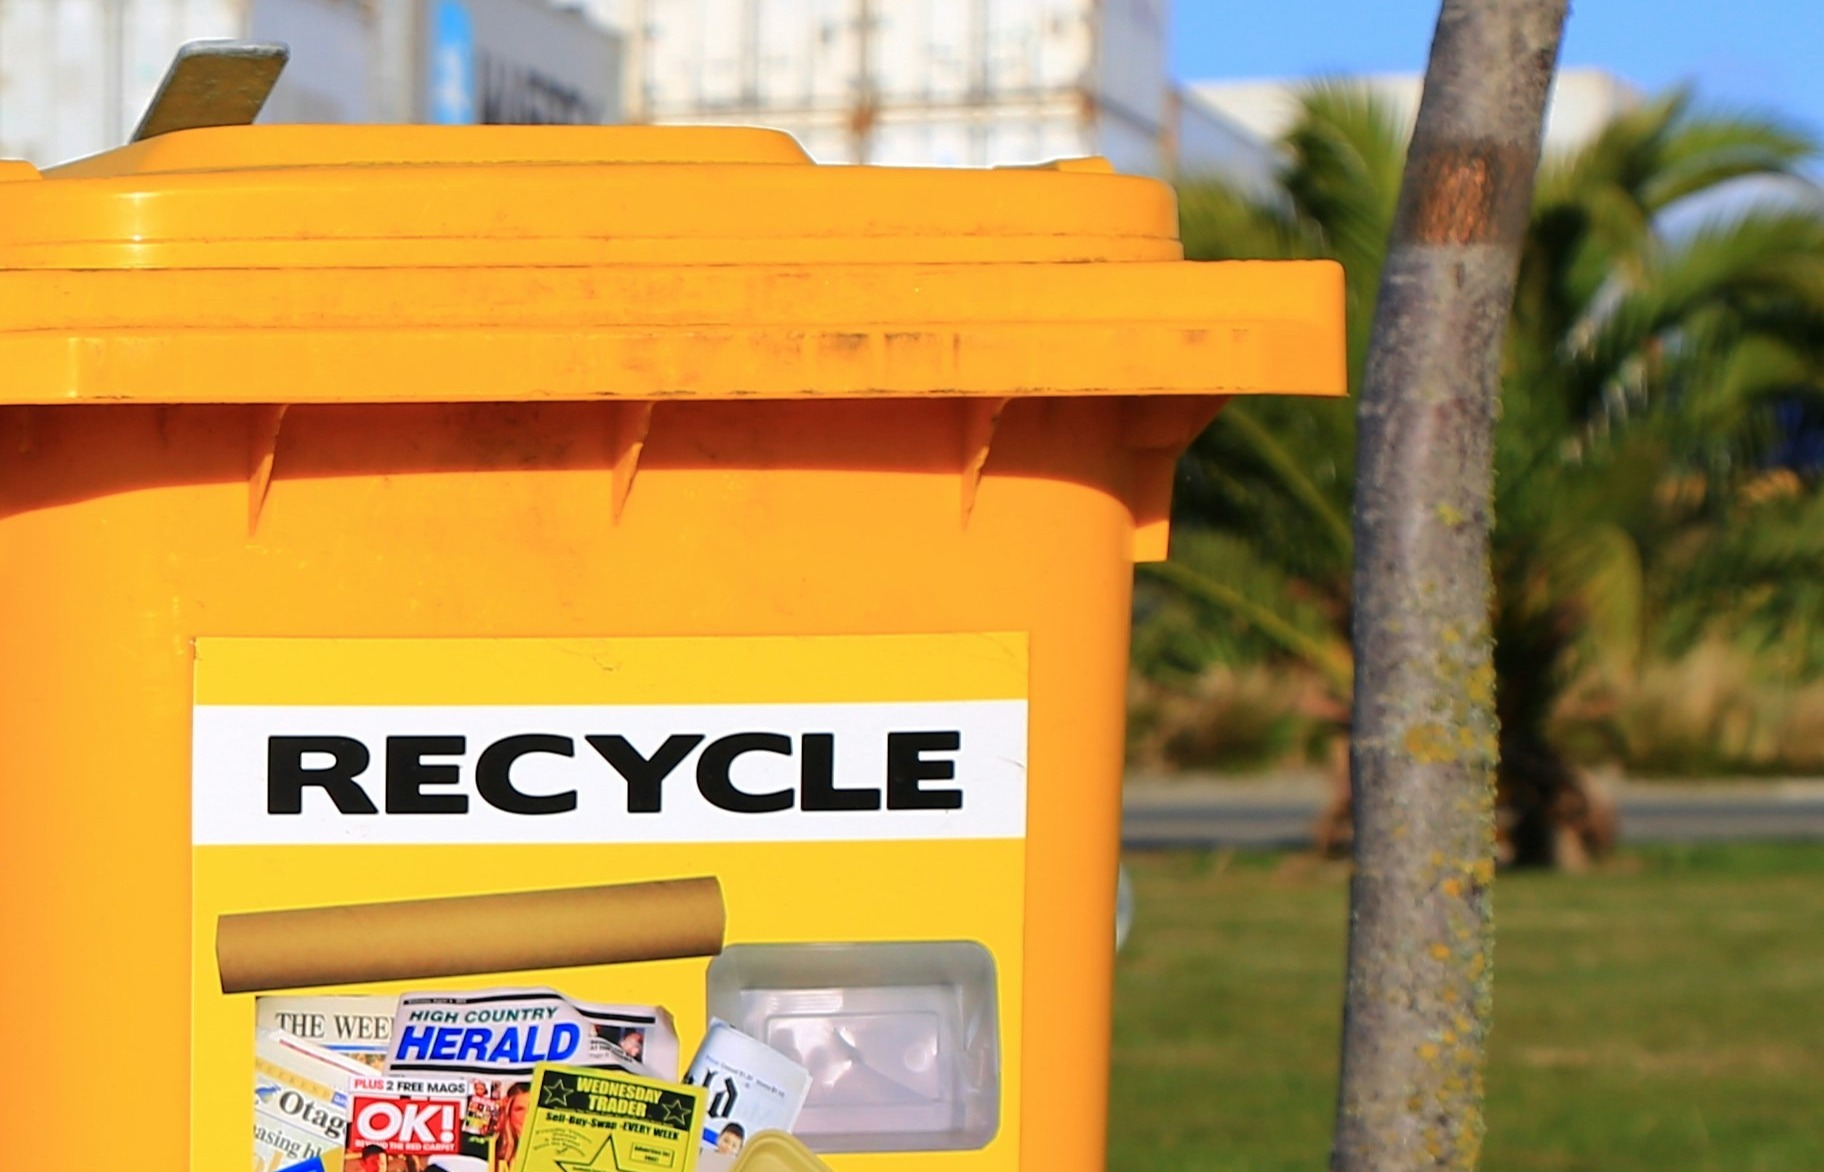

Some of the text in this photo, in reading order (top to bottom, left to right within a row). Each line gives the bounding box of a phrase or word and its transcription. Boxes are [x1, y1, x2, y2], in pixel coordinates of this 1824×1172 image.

[267, 730, 963, 816] RECYCLE
[275, 1011, 394, 1040] THE WEE
[409, 1006, 558, 1024] HIGH COUNTRY
[395, 1021, 582, 1063] HERALD
[354, 1078, 466, 1093] PLUS 2 FREE MAGS
[576, 1075, 663, 1104] WEDNESDAY
[588, 1094, 647, 1118] TRADER
[356, 1101, 457, 1143] OK!
[653, 1126, 680, 1142] WEEK
[255, 1125, 302, 1156] asing
[389, 1142, 405, 1151] THE
[406, 1142, 424, 1151] RED
[425, 1142, 455, 1152] CARPET
